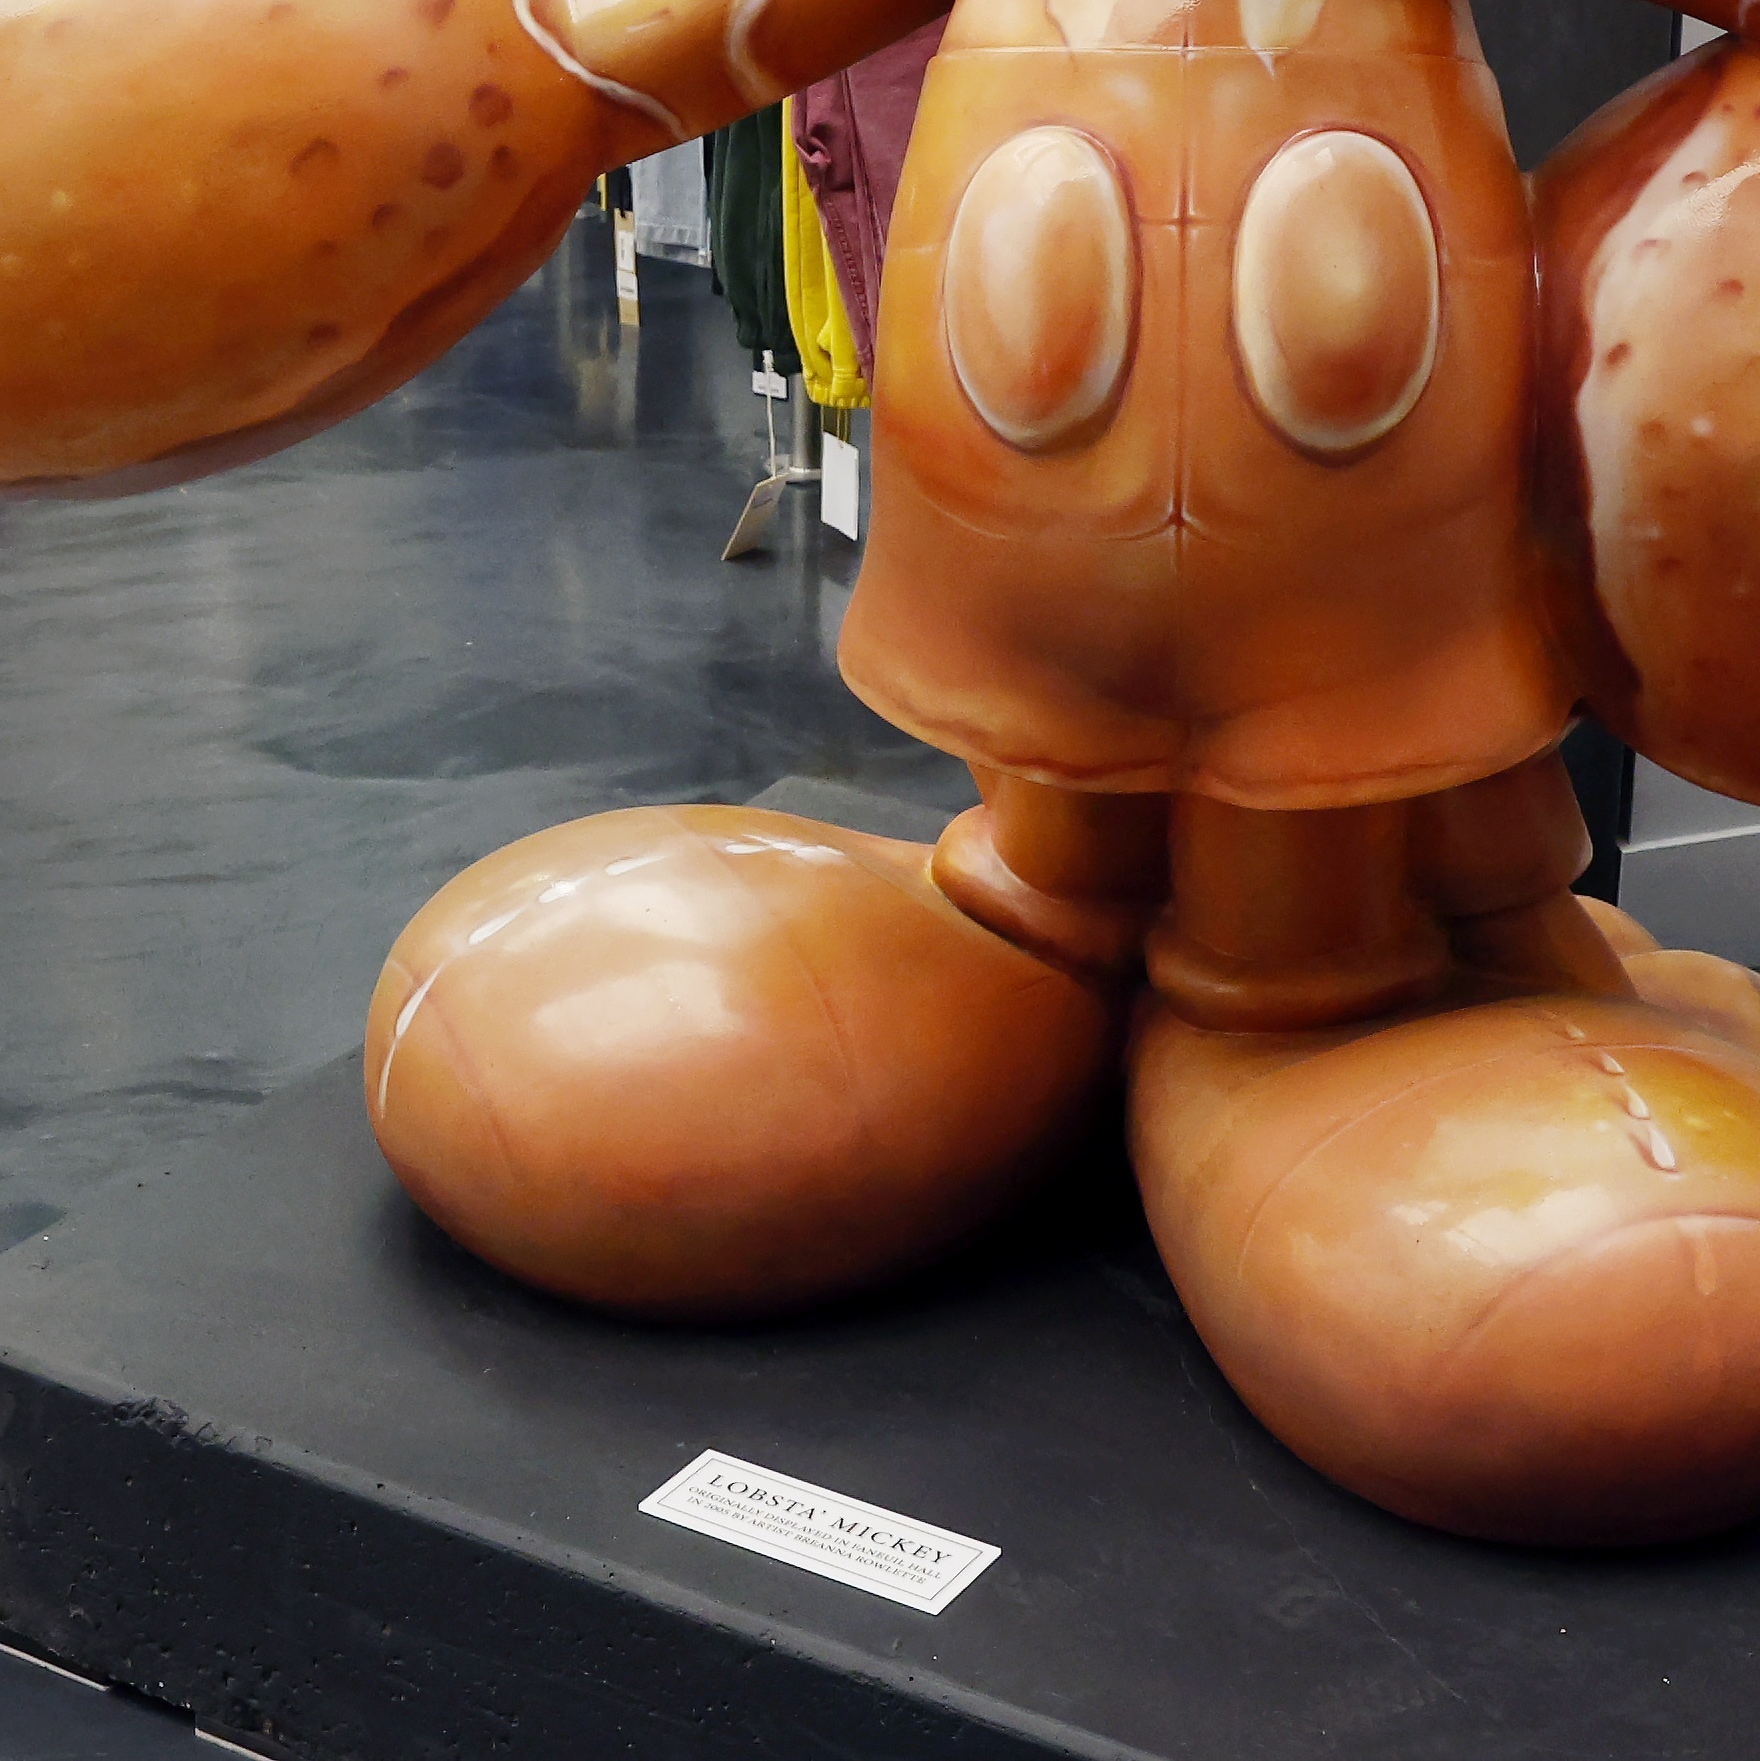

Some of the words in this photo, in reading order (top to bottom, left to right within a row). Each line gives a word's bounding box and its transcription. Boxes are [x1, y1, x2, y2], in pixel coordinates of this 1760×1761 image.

[687, 1496, 703, 1506] IN
[703, 1502, 730, 1516] 2005
[731, 1511, 749, 1521] BY
[750, 1517, 793, 1537] ARTIST
[793, 1534, 854, 1559] BREANNA
[855, 1553, 927, 1584] ROWLETTE
[688, 1486, 764, 1516] ORIGINALLY
[763, 1511, 833, 1541] DISPLAYED
[834, 1537, 851, 1549] IN
[851, 1543, 904, 1567] FANEUIL
[907, 1561, 941, 1579] HALL
[829, 1517, 952, 1564] MICKEY
